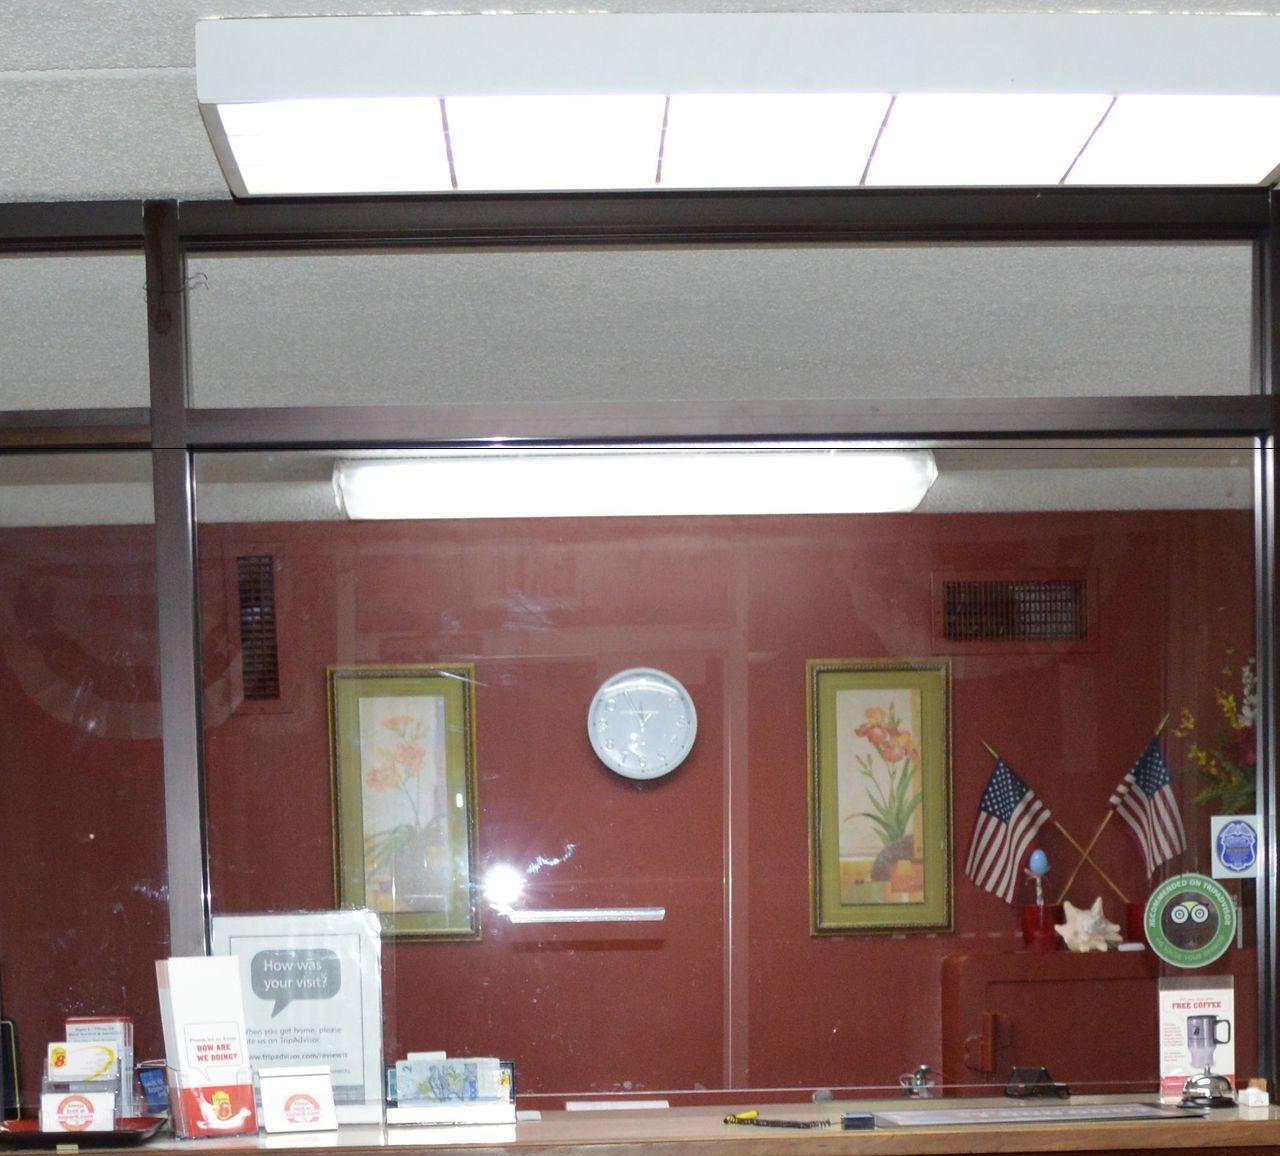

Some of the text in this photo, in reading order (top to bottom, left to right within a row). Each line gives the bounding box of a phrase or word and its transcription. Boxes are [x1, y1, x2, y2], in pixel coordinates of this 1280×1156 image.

[1149, 879, 1231, 928] RECOMMENDED ON TRIPADVISOR
[264, 959, 323, 972] How was
[264, 976, 328, 992] your visit?
[1172, 1001, 1222, 1009] FREE COFFEE
[246, 1028, 262, 1036] hen
[264, 1028, 278, 1037] you
[280, 1027, 292, 1037] get
[196, 1043, 231, 1052] HOW ARE
[211, 1053, 238, 1061] DOING?
[249, 1052, 349, 1062] ww.tripadvisor.com/reviewit
